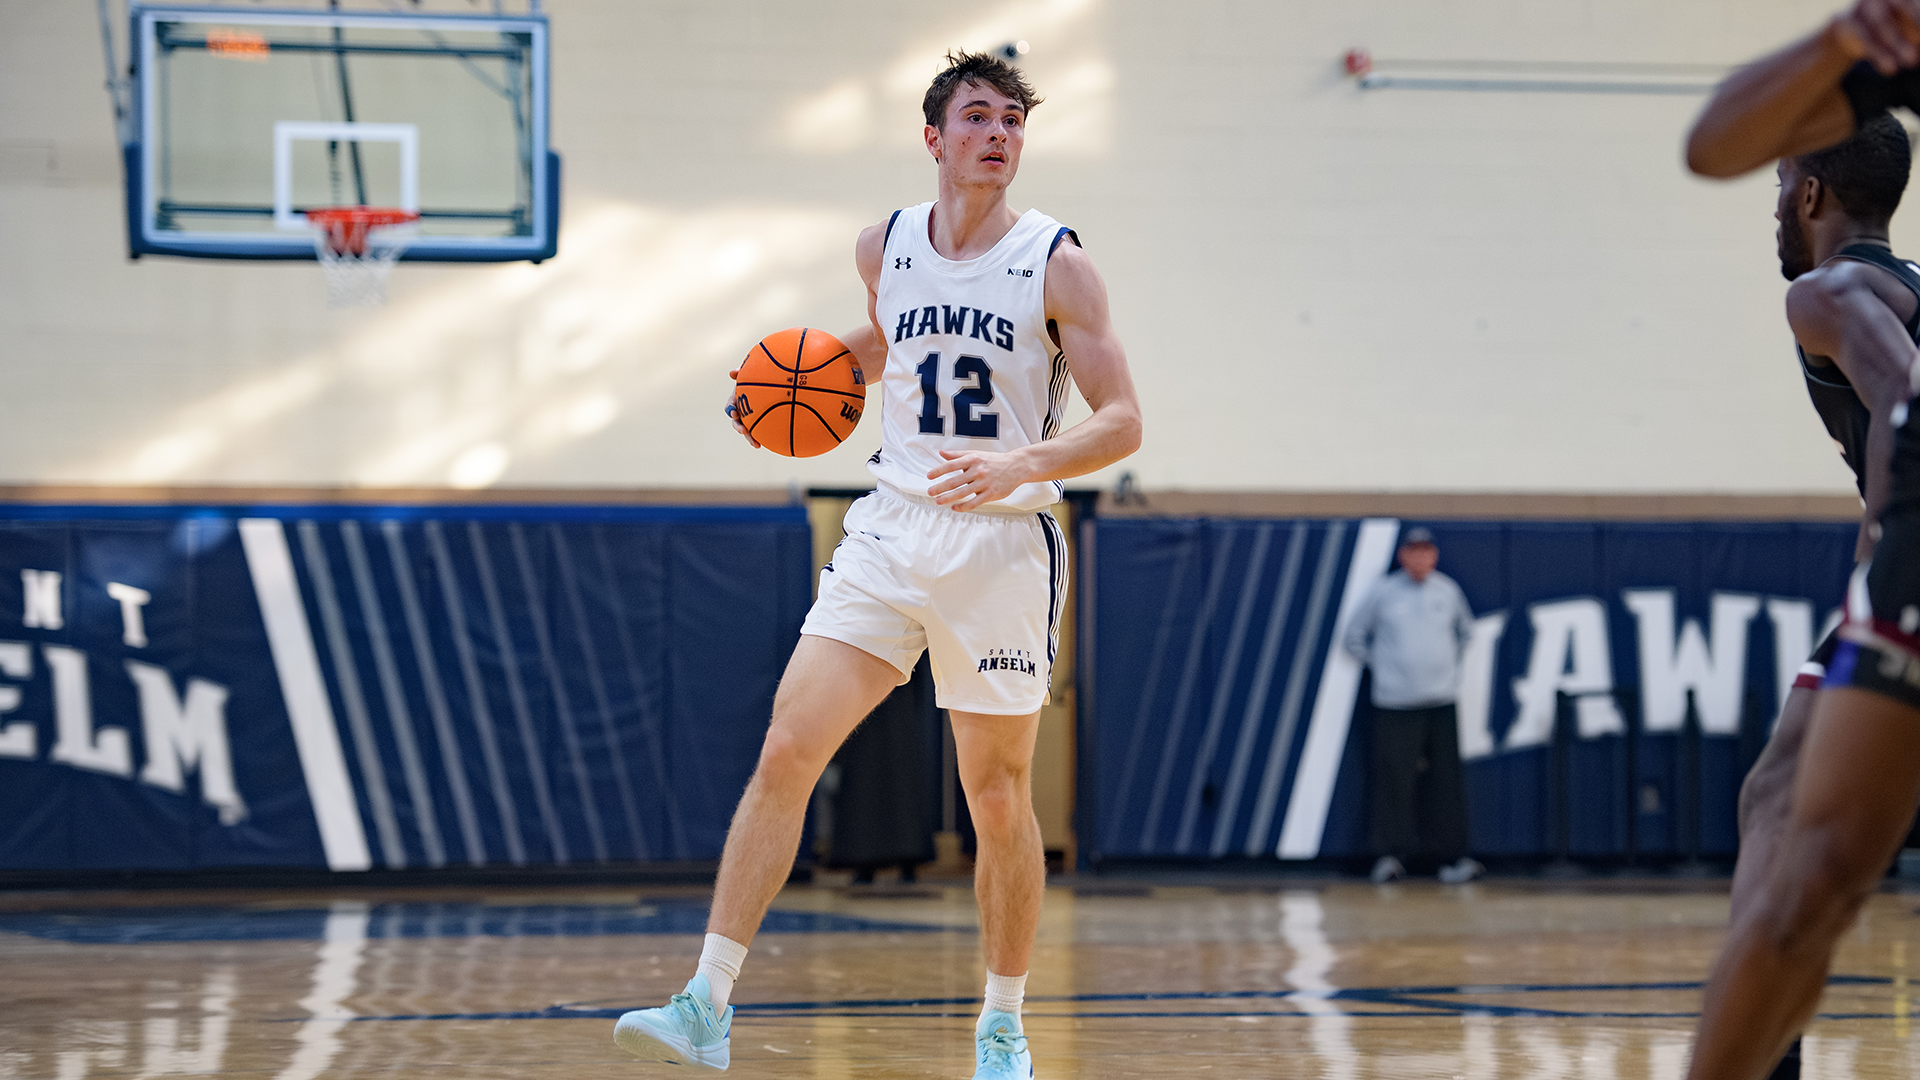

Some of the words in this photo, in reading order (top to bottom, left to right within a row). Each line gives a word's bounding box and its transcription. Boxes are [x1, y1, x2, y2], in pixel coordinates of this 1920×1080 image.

[894, 304, 1014, 352] HAWKS
[914, 351, 1000, 441] 12
[977, 656, 1036, 677] ANSELM
[988, 648, 1030, 658] SAINT
